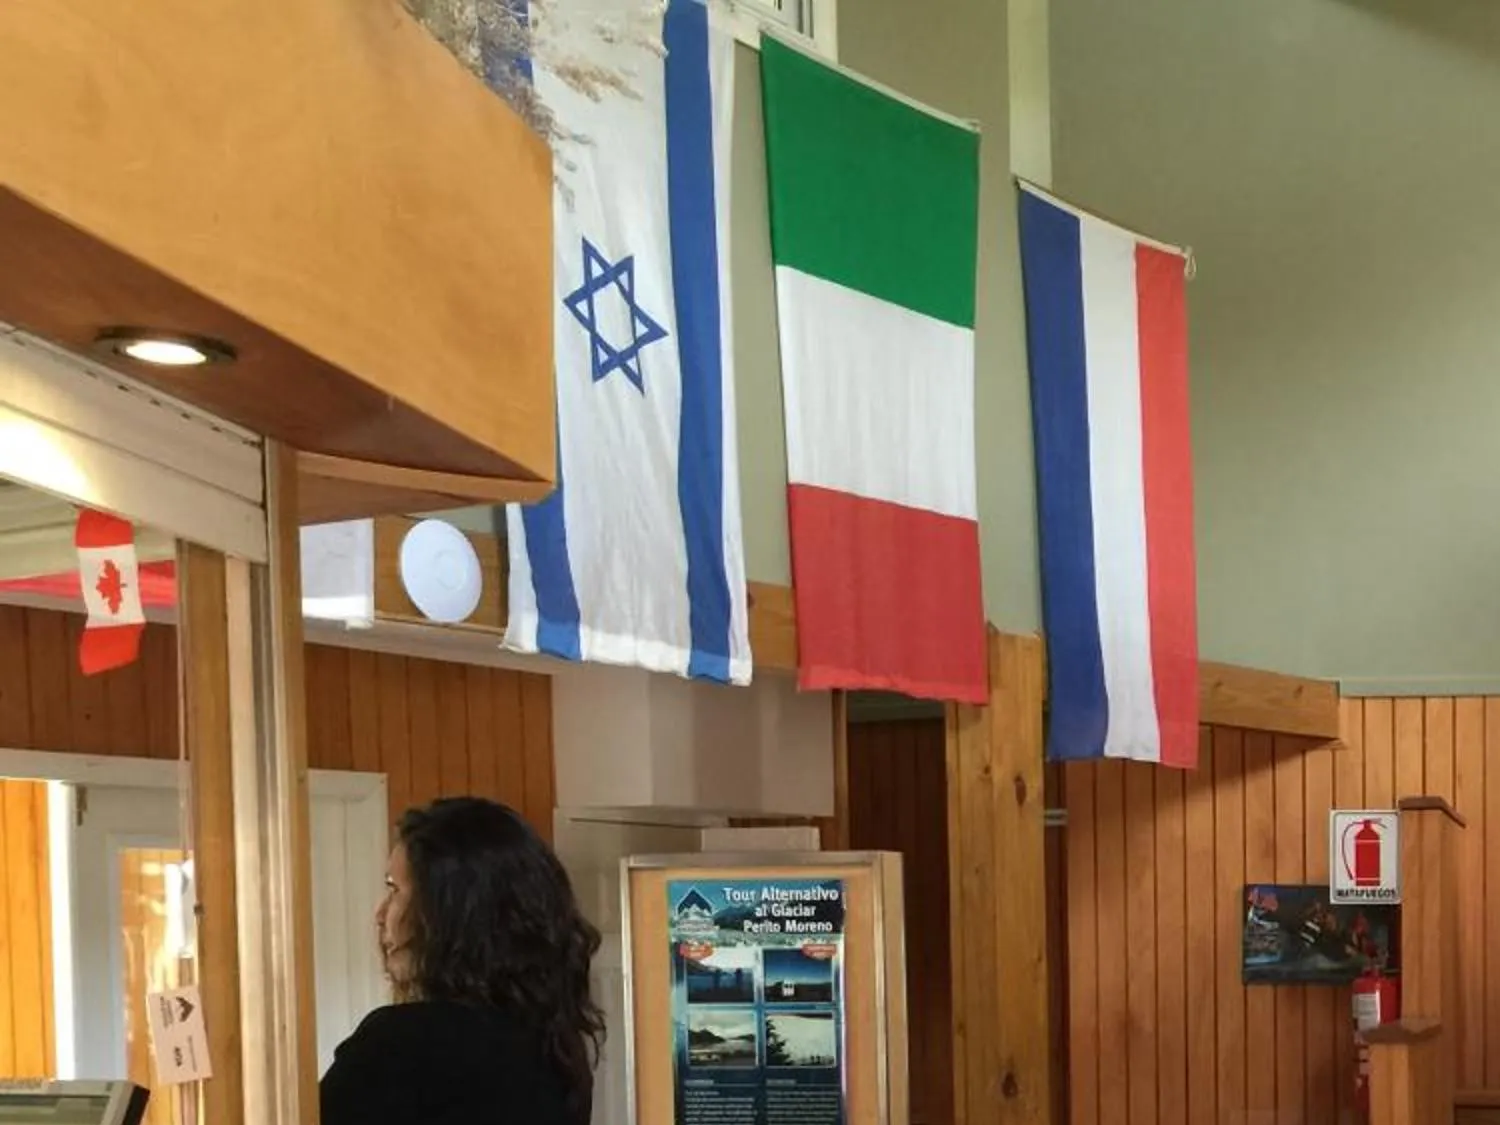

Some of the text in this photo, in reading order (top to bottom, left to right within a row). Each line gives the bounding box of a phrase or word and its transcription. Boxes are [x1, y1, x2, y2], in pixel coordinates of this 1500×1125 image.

[723, 886, 839, 902] Tour Alternativo
[1336, 888, 1396, 898] MATAFUEGOS
[755, 902, 816, 917] al Glaciar
[743, 919, 833, 933] Perito Moreno
